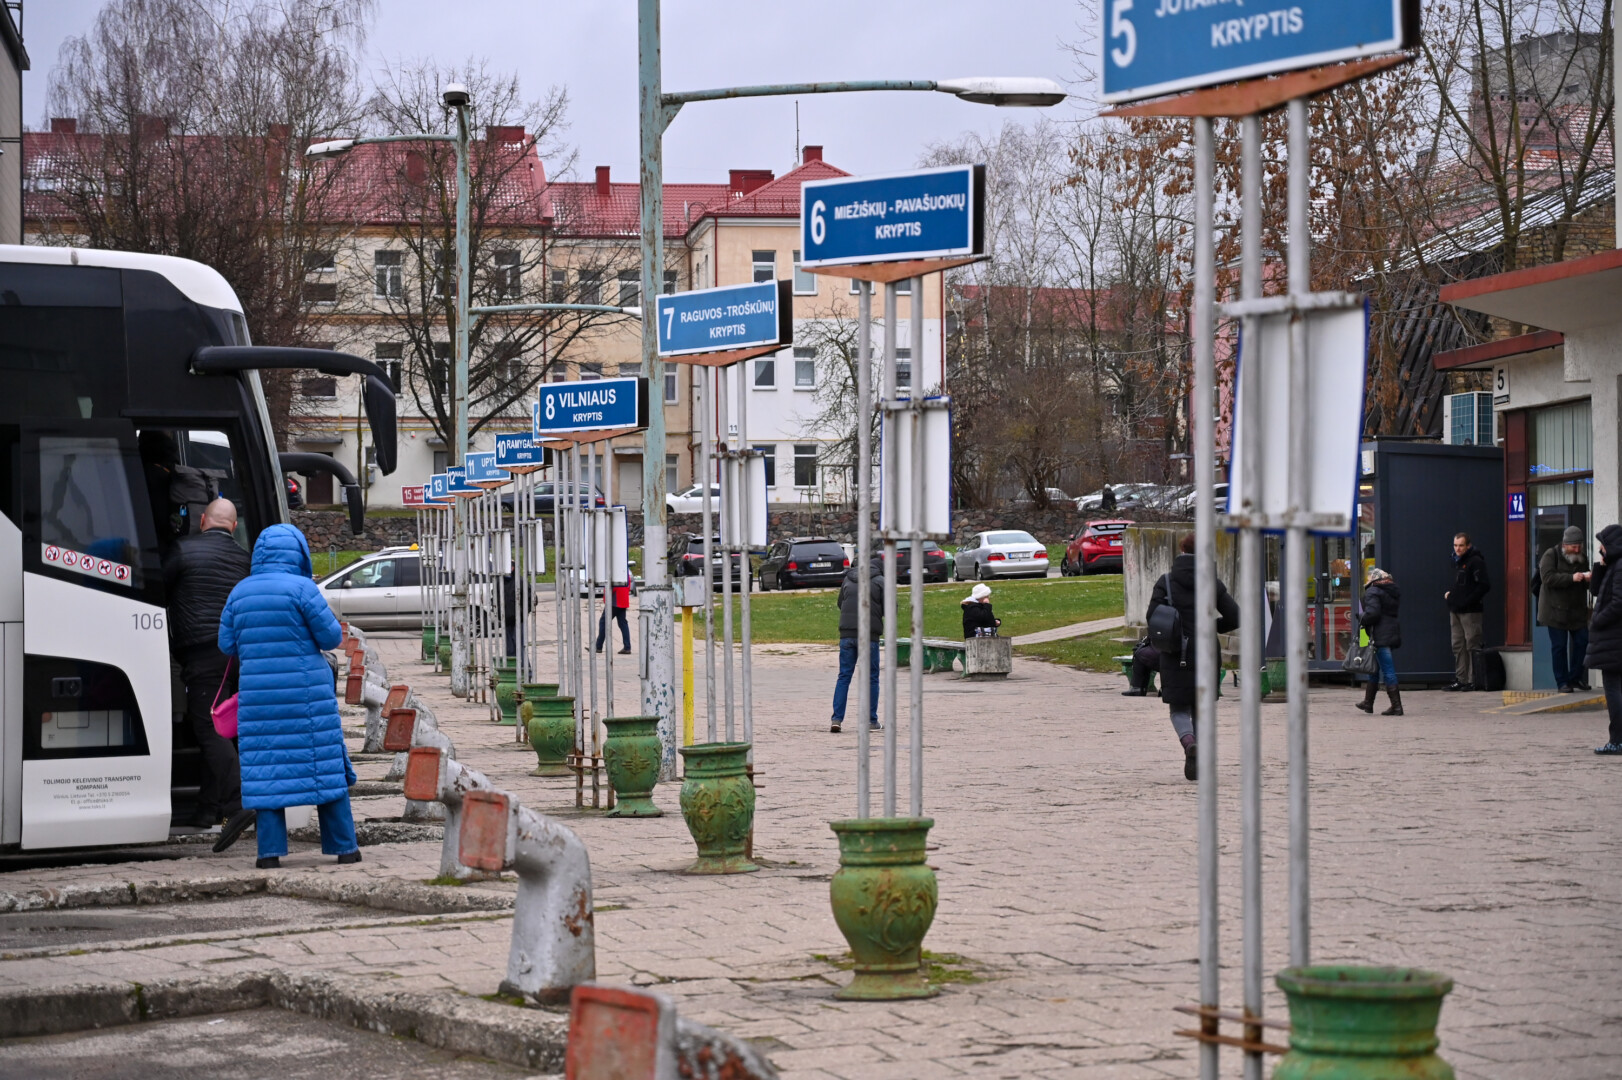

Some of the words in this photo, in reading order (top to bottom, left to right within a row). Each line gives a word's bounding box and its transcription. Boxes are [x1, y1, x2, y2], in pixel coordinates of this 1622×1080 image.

[1111, 0, 1137, 68] 5
[1210, 6, 1304, 48] KRYPTIS
[834, 200, 887, 220] MIEŽIŠKIŲ
[895, 192, 965, 213] PAVAŠUOKIŲ
[810, 199, 826, 245] 6
[875, 221, 921, 240] KRYPTIS
[663, 307, 675, 340] 7
[680, 307, 722, 323] RAGUVOS
[709, 323, 746, 339] KRYPTIS
[1497, 369, 1505, 391] 5
[545, 393, 555, 420] 8
[558, 388, 617, 408] VILNIAUS
[572, 411, 603, 423] KRYPTIS
[497, 440, 506, 459] 10
[506, 438, 541, 449] RAMYGAL
[468, 459, 475, 476] 11
[434, 479, 442, 493] 13
[448, 470, 456, 485] 12
[404, 489, 412, 500] 15
[131, 612, 163, 630] 106
